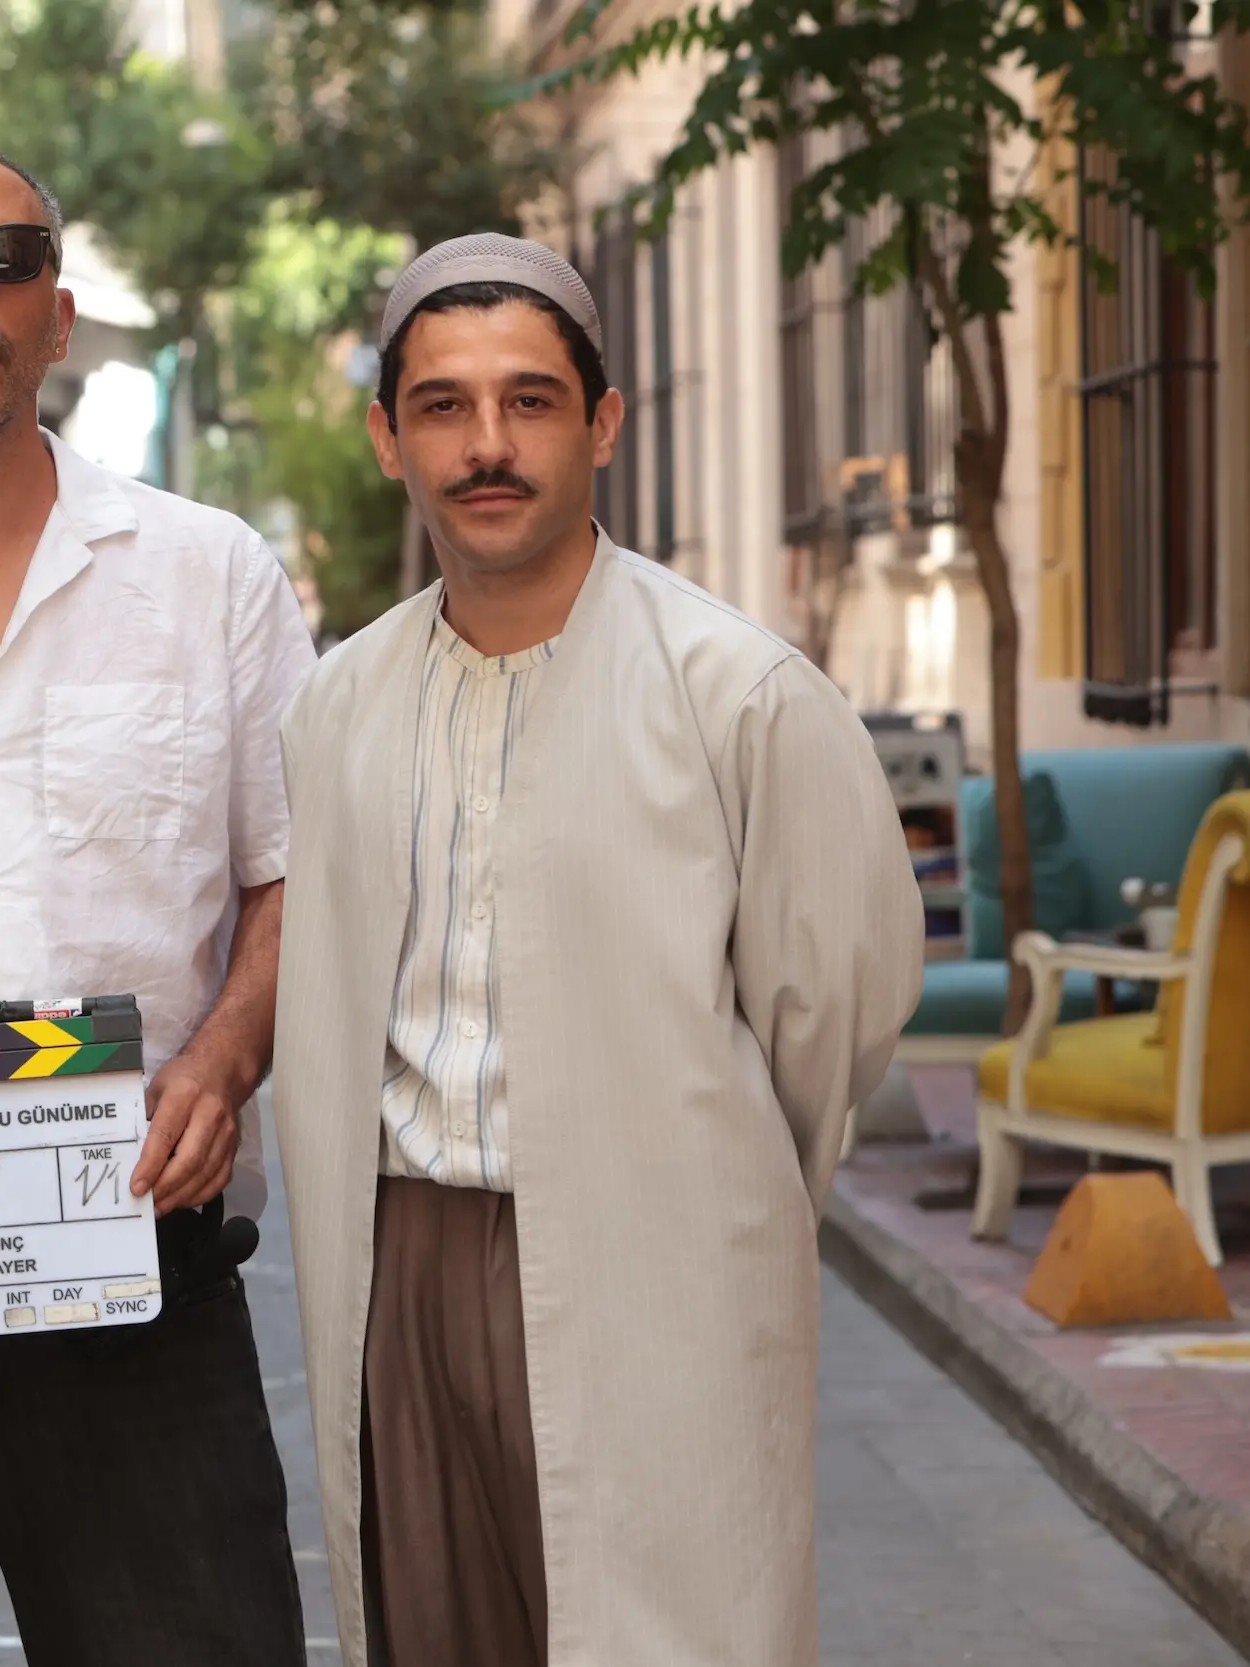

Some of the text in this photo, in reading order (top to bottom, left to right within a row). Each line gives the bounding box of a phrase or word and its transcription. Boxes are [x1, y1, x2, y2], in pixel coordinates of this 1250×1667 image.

[17, 1102, 117, 1125] GÜNÜMDE
[81, 1147, 113, 1161] TAKE
[6, 1290, 31, 1305] INT
[52, 1286, 83, 1301] DAY
[105, 1299, 148, 1315] SYNC
